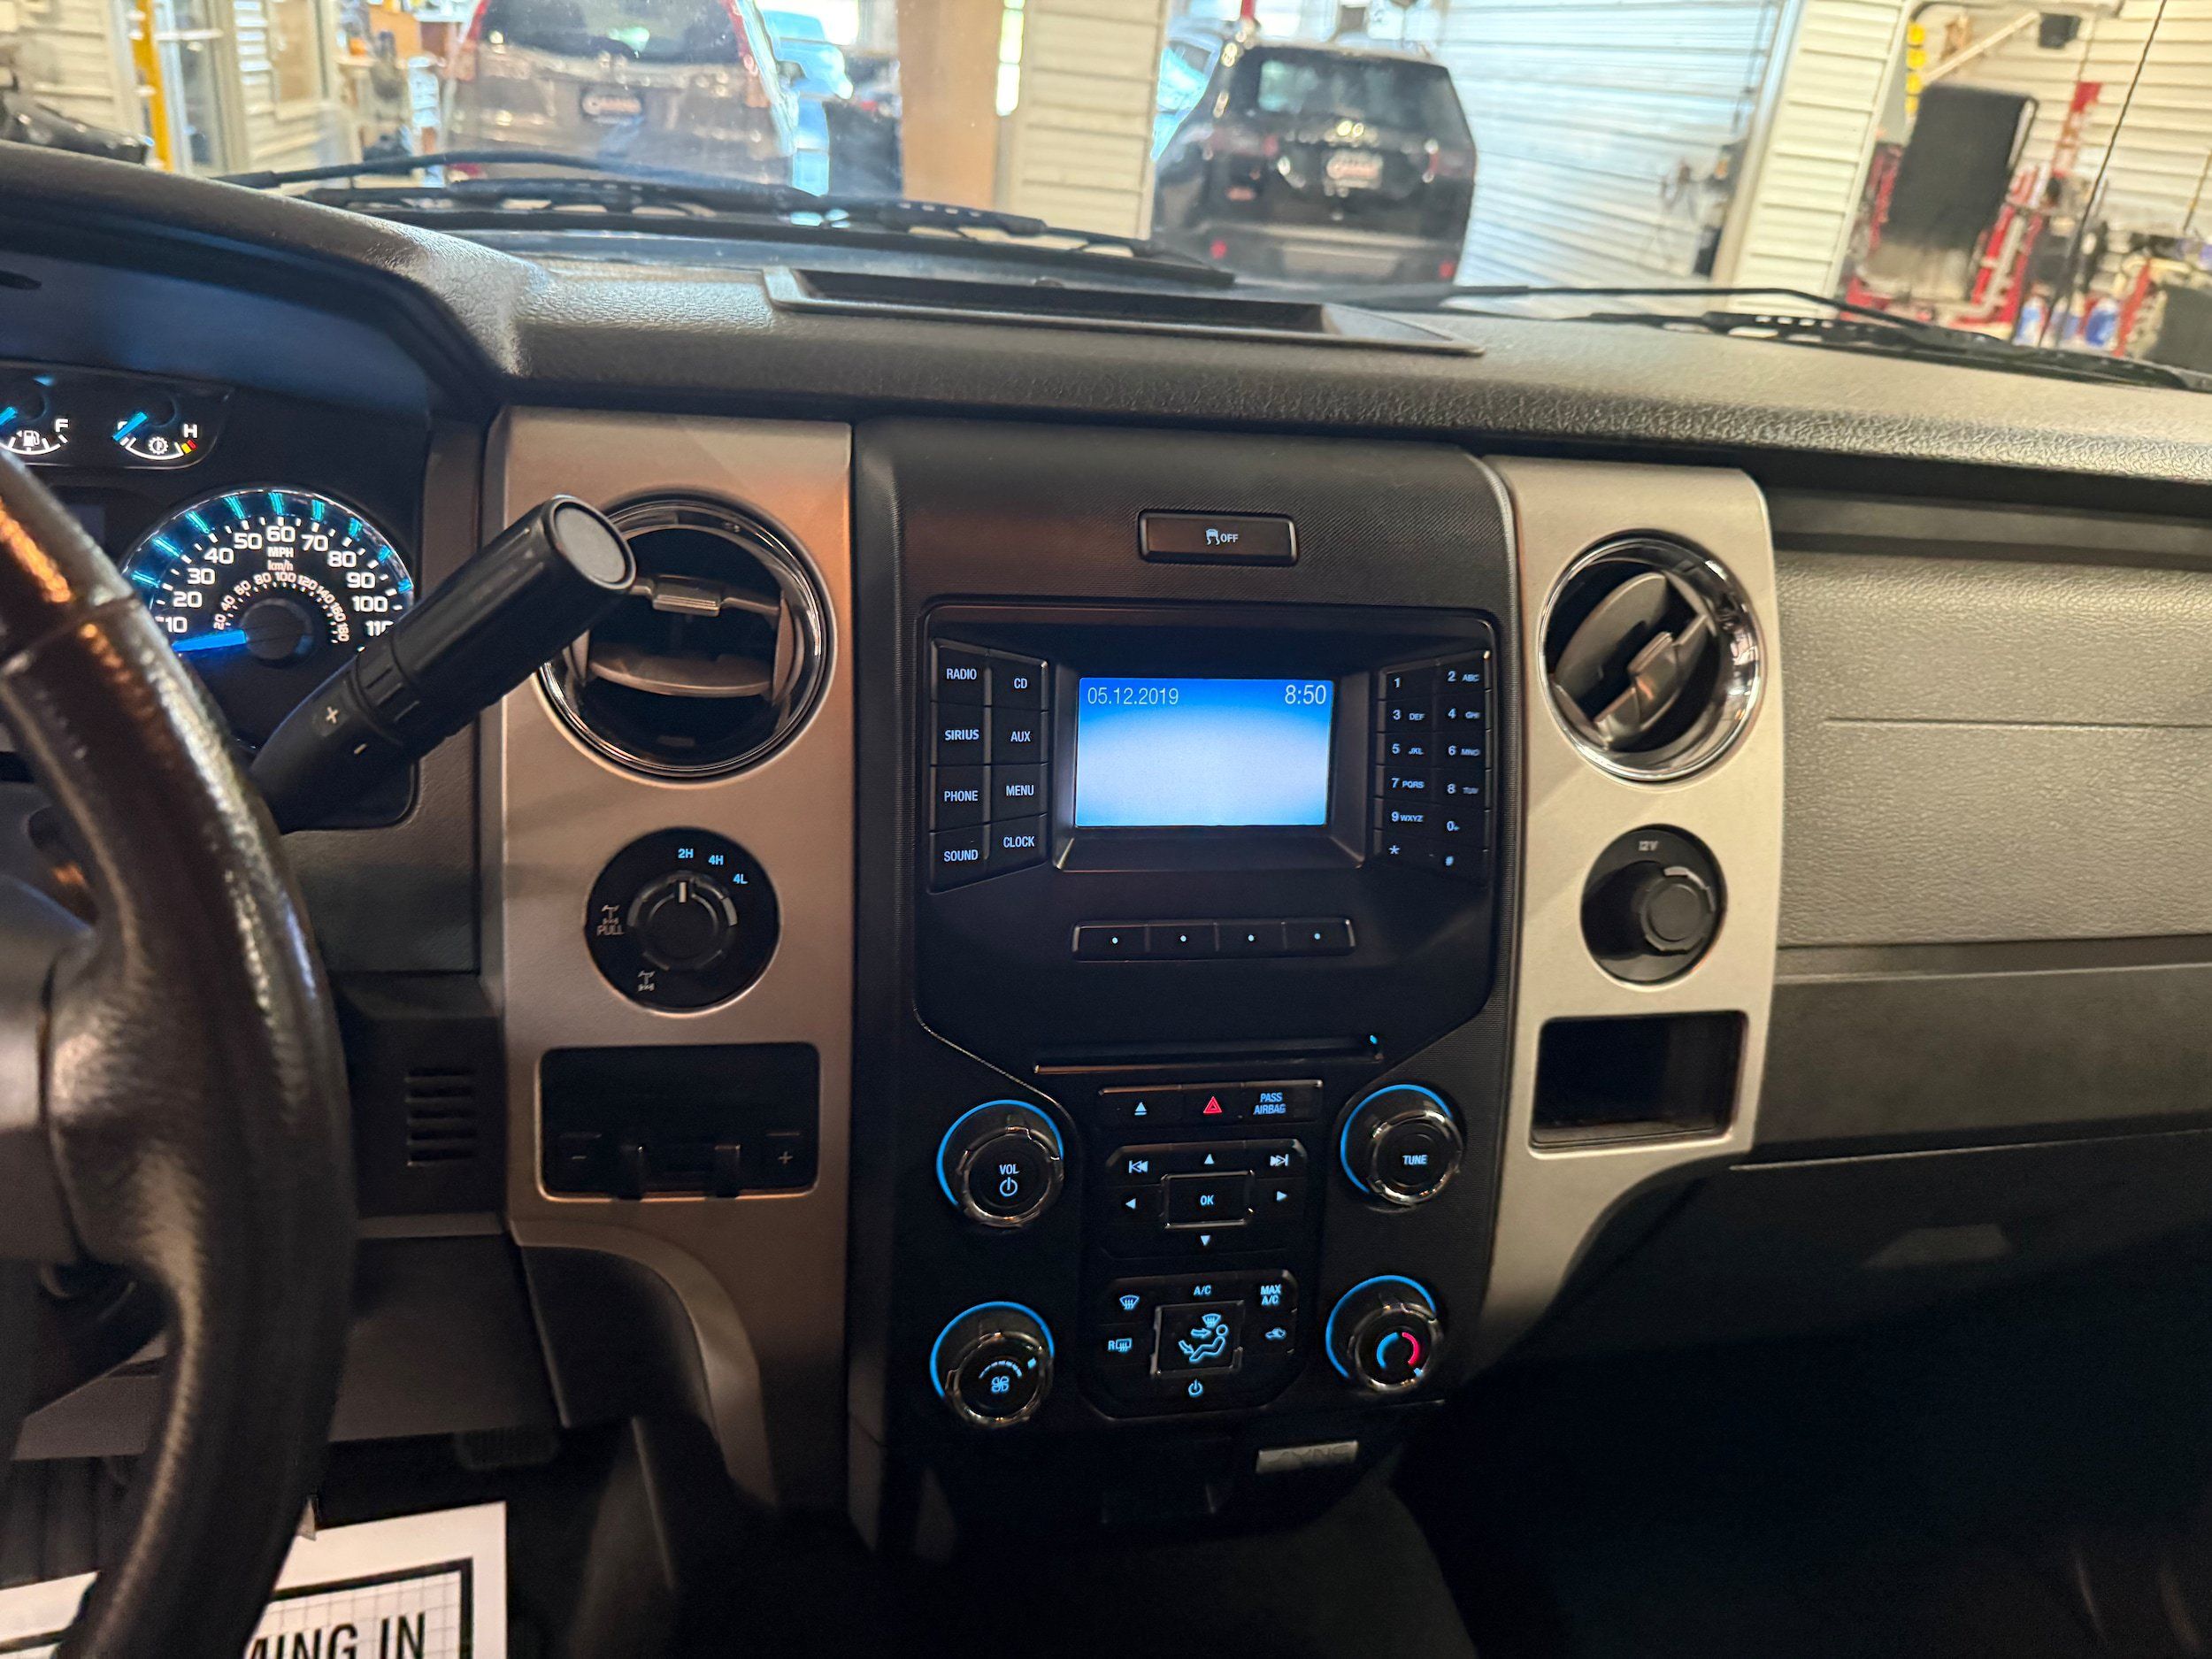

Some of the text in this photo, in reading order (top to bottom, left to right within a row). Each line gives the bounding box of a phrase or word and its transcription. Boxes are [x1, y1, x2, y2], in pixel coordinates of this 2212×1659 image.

[56, 419, 68, 432] F
[183, 423, 197, 438] H
[267, 526, 296, 542] 60
[1220, 534, 1239, 543] OFF
[234, 533, 263, 549] 50
[302, 534, 328, 552] 70
[204, 548, 234, 565] 40
[267, 546, 294, 558] MPH
[327, 550, 357, 567] 80
[267, 559, 294, 571] km/h
[187, 568, 215, 585] 30
[253, 572, 272, 585] 80
[275, 572, 296, 583] 100
[296, 574, 319, 591] 120
[345, 572, 375, 588] 90
[234, 580, 251, 595] 60
[173, 591, 202, 608] 20
[316, 585, 335, 604] 140
[220, 595, 235, 611] 40
[351, 595, 388, 612] 100
[330, 602, 346, 622] 160
[165, 617, 188, 633] 10
[213, 614, 227, 630] 20
[337, 623, 349, 641] 180
[946, 668, 977, 680] RADIO
[1448, 671, 1456, 682] 2
[1014, 678, 1027, 689] CD
[1394, 678, 1401, 688] 1
[1087, 684, 1326, 705] 05.12.2019 8:50
[1393, 710, 1425, 721] 3 DEF
[1448, 708, 1456, 719] 4
[944, 729, 979, 741] SIRIUS
[1010, 731, 1031, 742] AUX
[1392, 744, 1401, 755] 5
[1448, 746, 1456, 756] 6
[1392, 778, 1425, 789] 7 PQRS
[1447, 784, 1456, 794] 8
[944, 790, 979, 802] PHONE
[1006, 785, 1034, 796] MENU
[1392, 811, 1424, 823] 9 WXYZ
[1003, 835, 1035, 848] CLOCK
[1639, 841, 1659, 851] 12V
[678, 848, 694, 859] 2H
[943, 849, 979, 862] SOUND
[709, 856, 724, 865] 4H
[733, 873, 748, 885] 4L
[596, 925, 624, 936] PULL
[1260, 1092, 1283, 1102] PASS
[1253, 1103, 1286, 1116] AIRBAG
[1402, 1154, 1428, 1165] TUNE
[999, 1164, 1020, 1176] VOL
[1200, 1195, 1215, 1206] OK
[1194, 1285, 1211, 1296] A/C
[1260, 1284, 1281, 1294] MAX
[1261, 1294, 1280, 1306] A/C
[380, 1611, 426, 1659] IN
